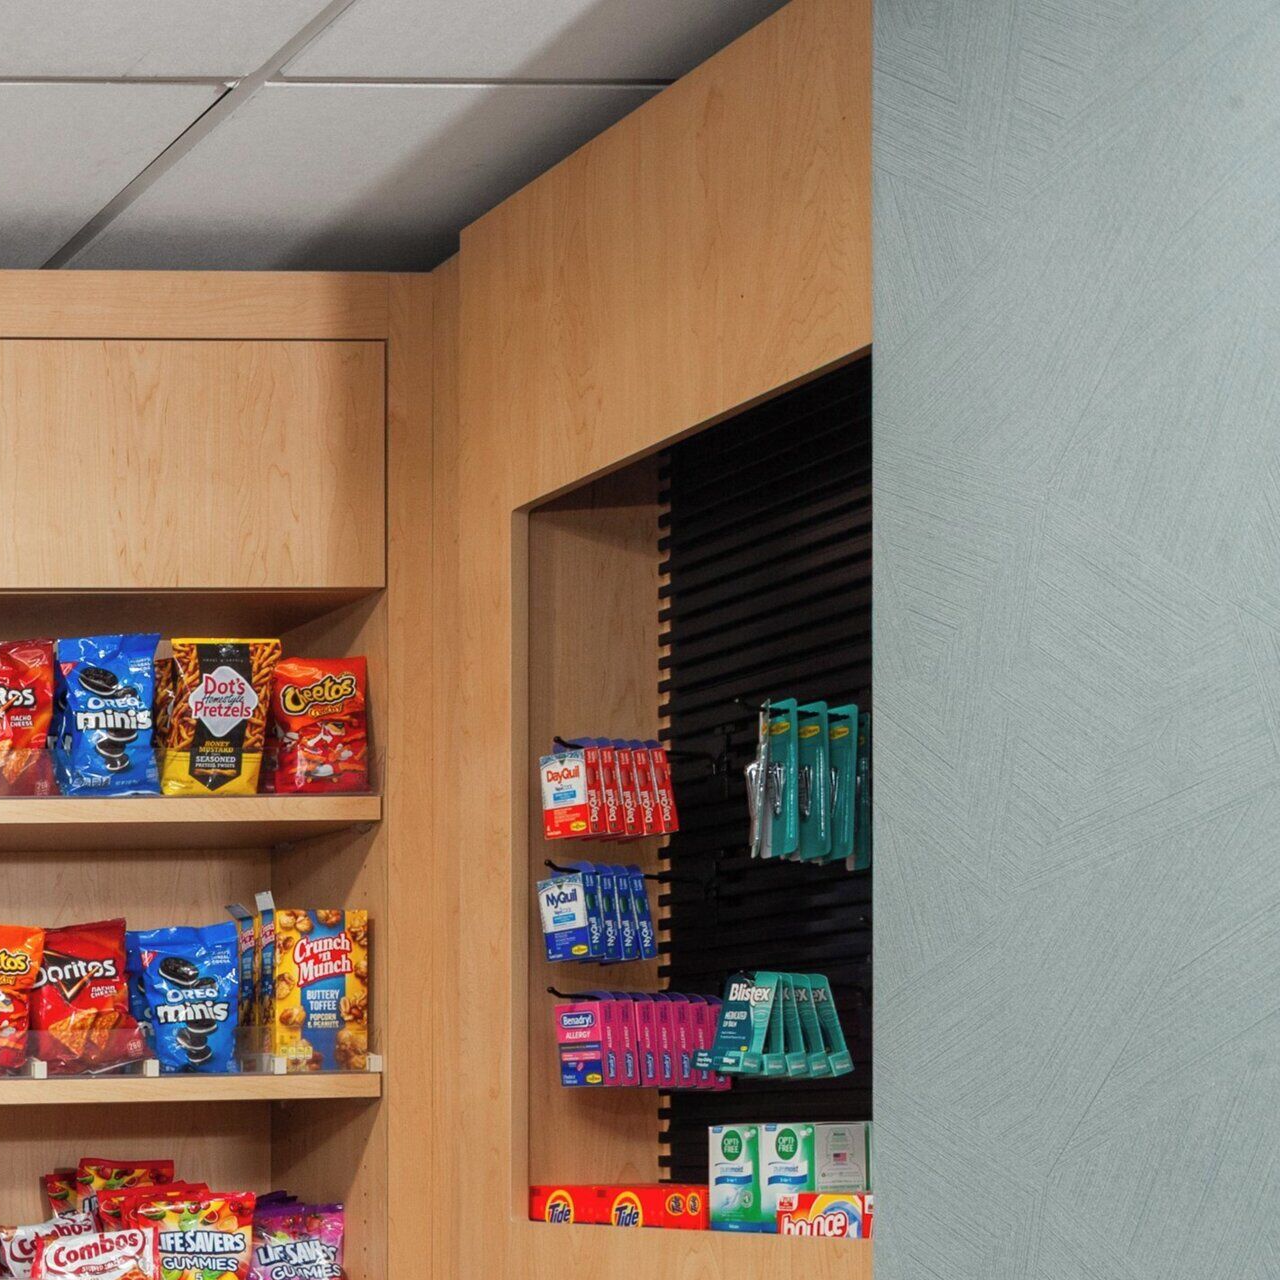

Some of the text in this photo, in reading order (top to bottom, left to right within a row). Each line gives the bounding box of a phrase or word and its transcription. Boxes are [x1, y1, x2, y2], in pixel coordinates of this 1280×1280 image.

[204, 676, 245, 695] Dot's
[283, 676, 355, 713] Cheetos
[77, 710, 153, 730] minis
[194, 703, 252, 717] Pretzels
[546, 766, 580, 784] DayQuil
[588, 789, 599, 822] DayQuil
[606, 789, 617, 821] DayQuil
[624, 791, 635, 823] DayQuil
[641, 791, 653, 823] DayQuil
[659, 789, 671, 820] DayQuil
[546, 889, 577, 908] NyQuil
[589, 917, 601, 943] NyQuil
[605, 920, 616, 947] NyQuil
[622, 920, 633, 947] NyQuil
[640, 921, 652, 947] NyQuil
[294, 933, 350, 963] Crunch
[33, 960, 116, 988] Doritos
[299, 954, 351, 985] Munch
[166, 988, 218, 1002] OREO
[307, 990, 339, 1000] BUTTERY
[310, 1001, 337, 1010] TOFFEE
[729, 983, 771, 1006] Blistex
[158, 1002, 229, 1023] minis
[563, 1014, 592, 1028] Benadryl
[566, 1031, 591, 1039] ALLERGY
[723, 1145, 739, 1153] FREE
[778, 1144, 794, 1152] FREE
[549, 1203, 571, 1223] Tide
[615, 1204, 639, 1227] Tide
[54, 1232, 138, 1268] Combos
[185, 1231, 245, 1252] SAVERS
[162, 1257, 238, 1271] GUMMIES
